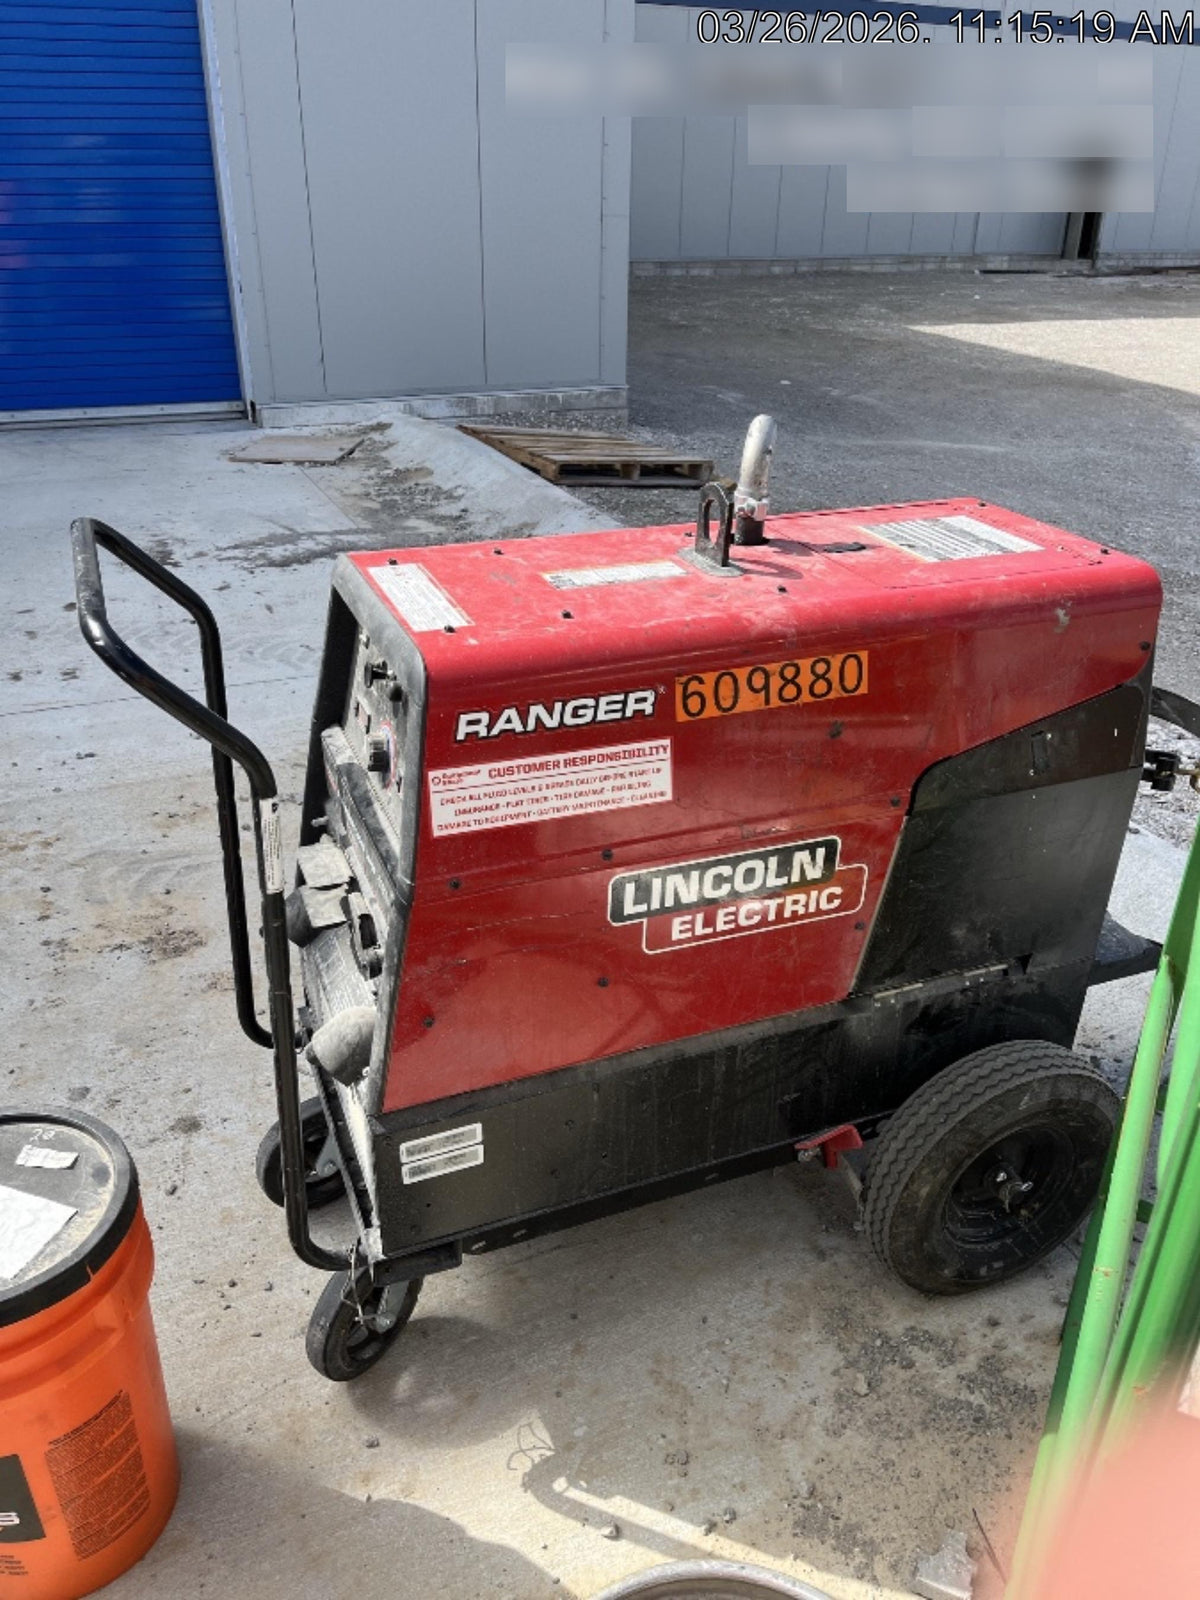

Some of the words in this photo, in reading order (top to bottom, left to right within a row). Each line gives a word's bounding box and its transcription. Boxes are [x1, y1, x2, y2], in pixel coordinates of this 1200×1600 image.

[680, 653, 864, 718] 609880
[487, 758, 561, 779] CUSTOMER
[563, 744, 669, 768] RESPONSIBILITY
[623, 847, 826, 916] LINCOLN
[671, 886, 843, 941] ELECTRIC
